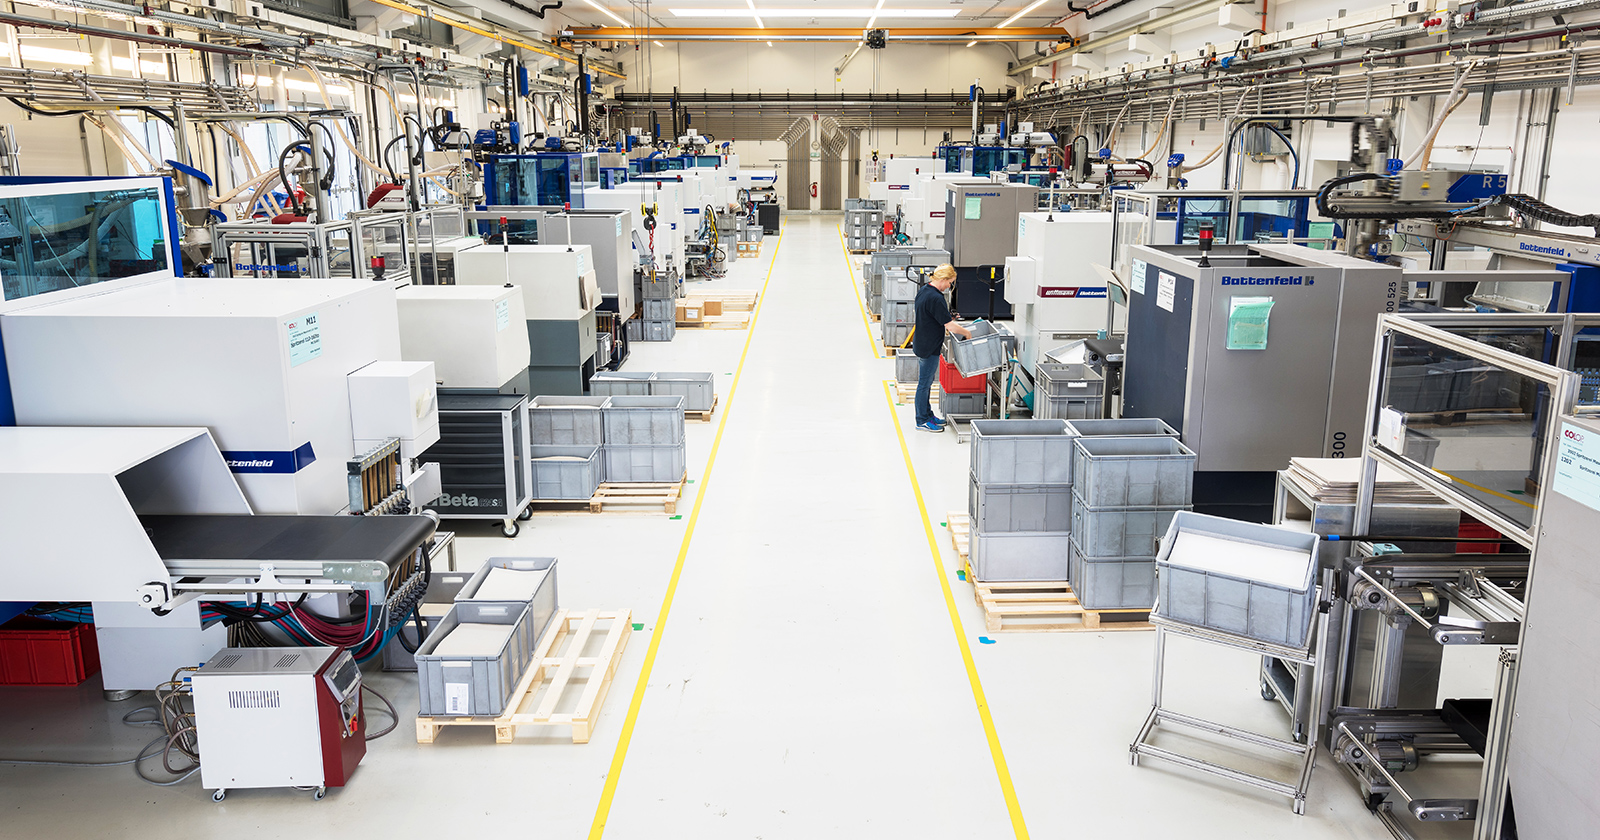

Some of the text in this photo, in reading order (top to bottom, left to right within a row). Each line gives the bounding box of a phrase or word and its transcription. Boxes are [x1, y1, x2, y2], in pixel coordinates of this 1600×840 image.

[1482, 175, 1507, 188] R 5
[1519, 242, 1565, 256] Battenfeld
[235, 263, 297, 272] Battenfeld
[1221, 275, 1302, 286] Battenfeld
[1387, 281, 1397, 298] 525
[305, 316, 317, 325] M11
[1331, 432, 1346, 459] 300
[439, 493, 479, 507] Beta
